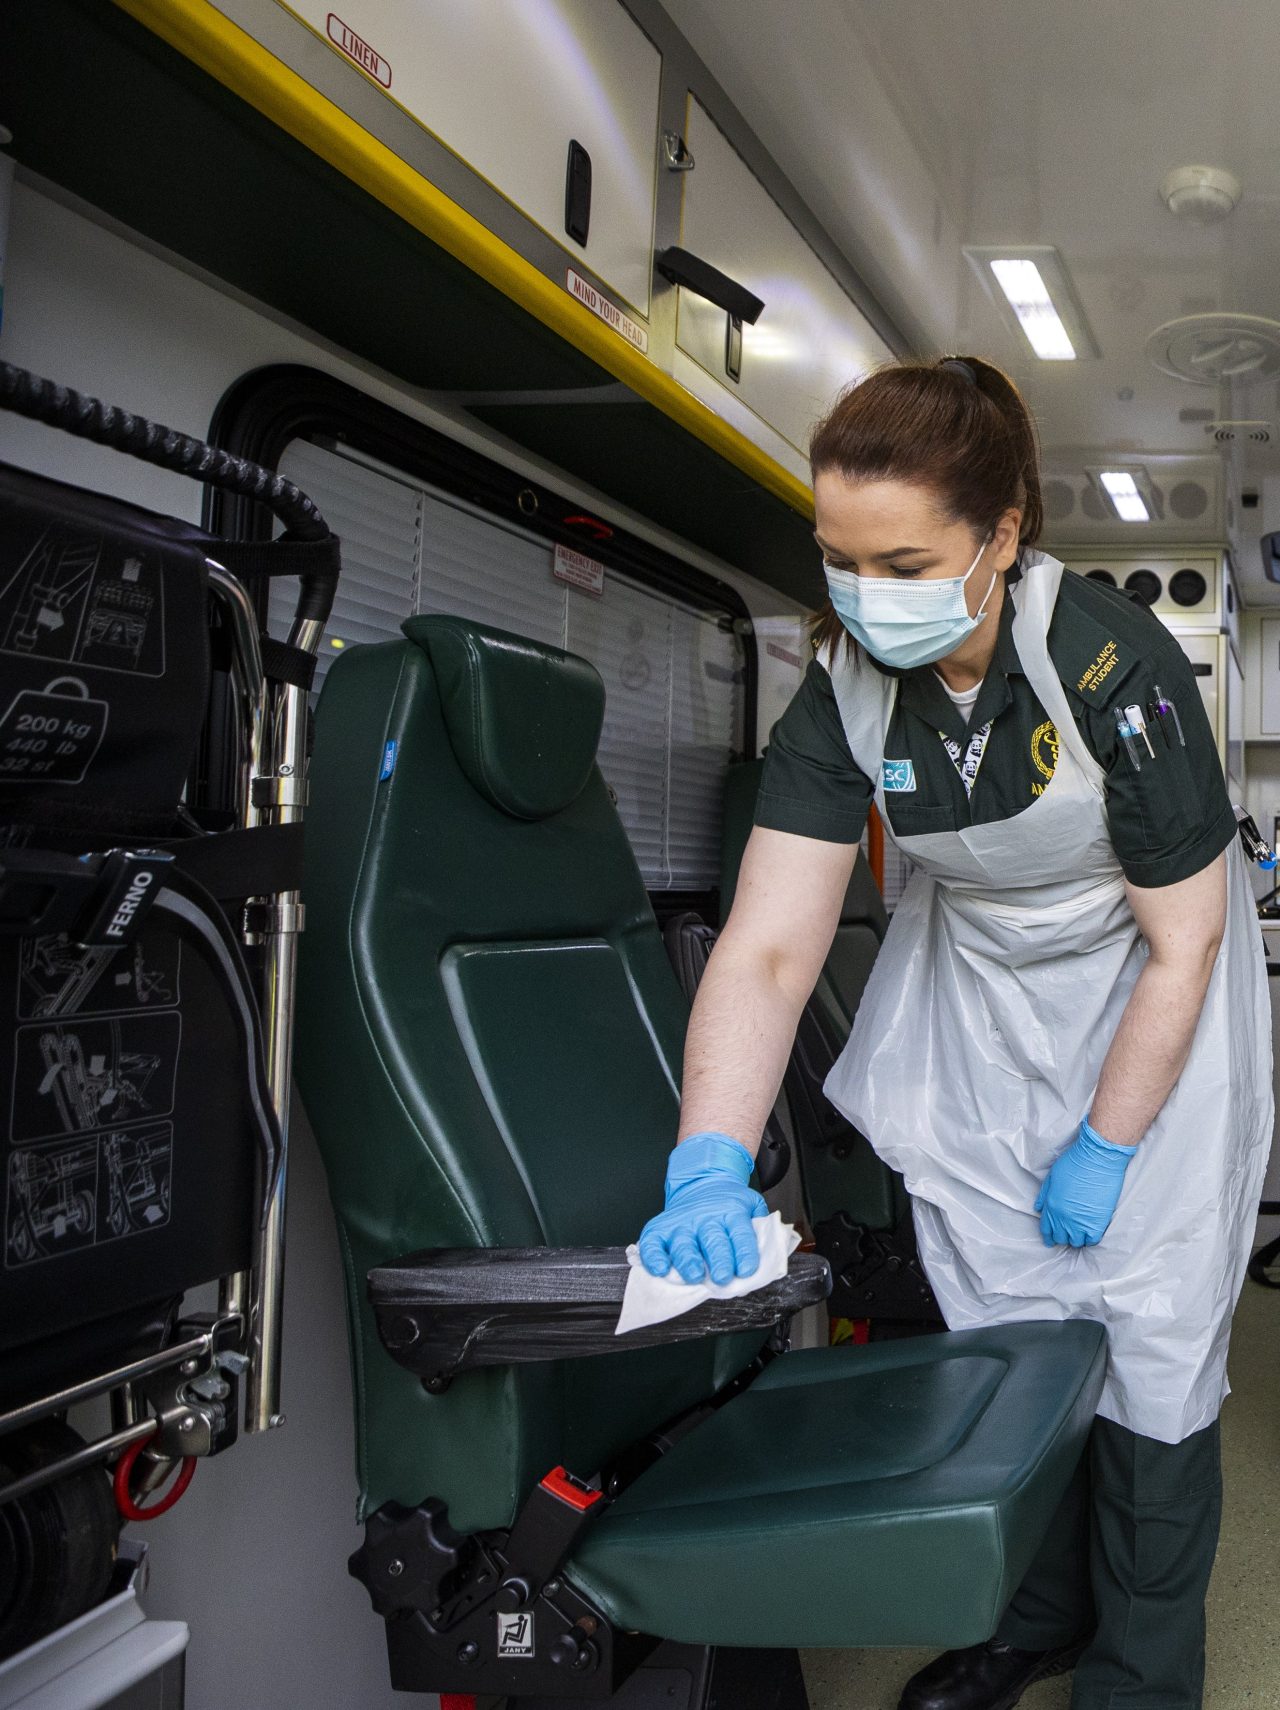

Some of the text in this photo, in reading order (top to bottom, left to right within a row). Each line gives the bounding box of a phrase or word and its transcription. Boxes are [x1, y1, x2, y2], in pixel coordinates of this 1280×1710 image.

[342, 28, 379, 75] LINEN
[573, 276, 643, 346] MIND YOUR HEAD
[1076, 640, 1117, 692] AMBULANCE
[1088, 653, 1119, 691] STUDENT
[5, 737, 78, 755] 440 lb
[15, 713, 92, 739] 200 kg
[882, 768, 906, 782] SC
[106, 871, 153, 937] FERNO
